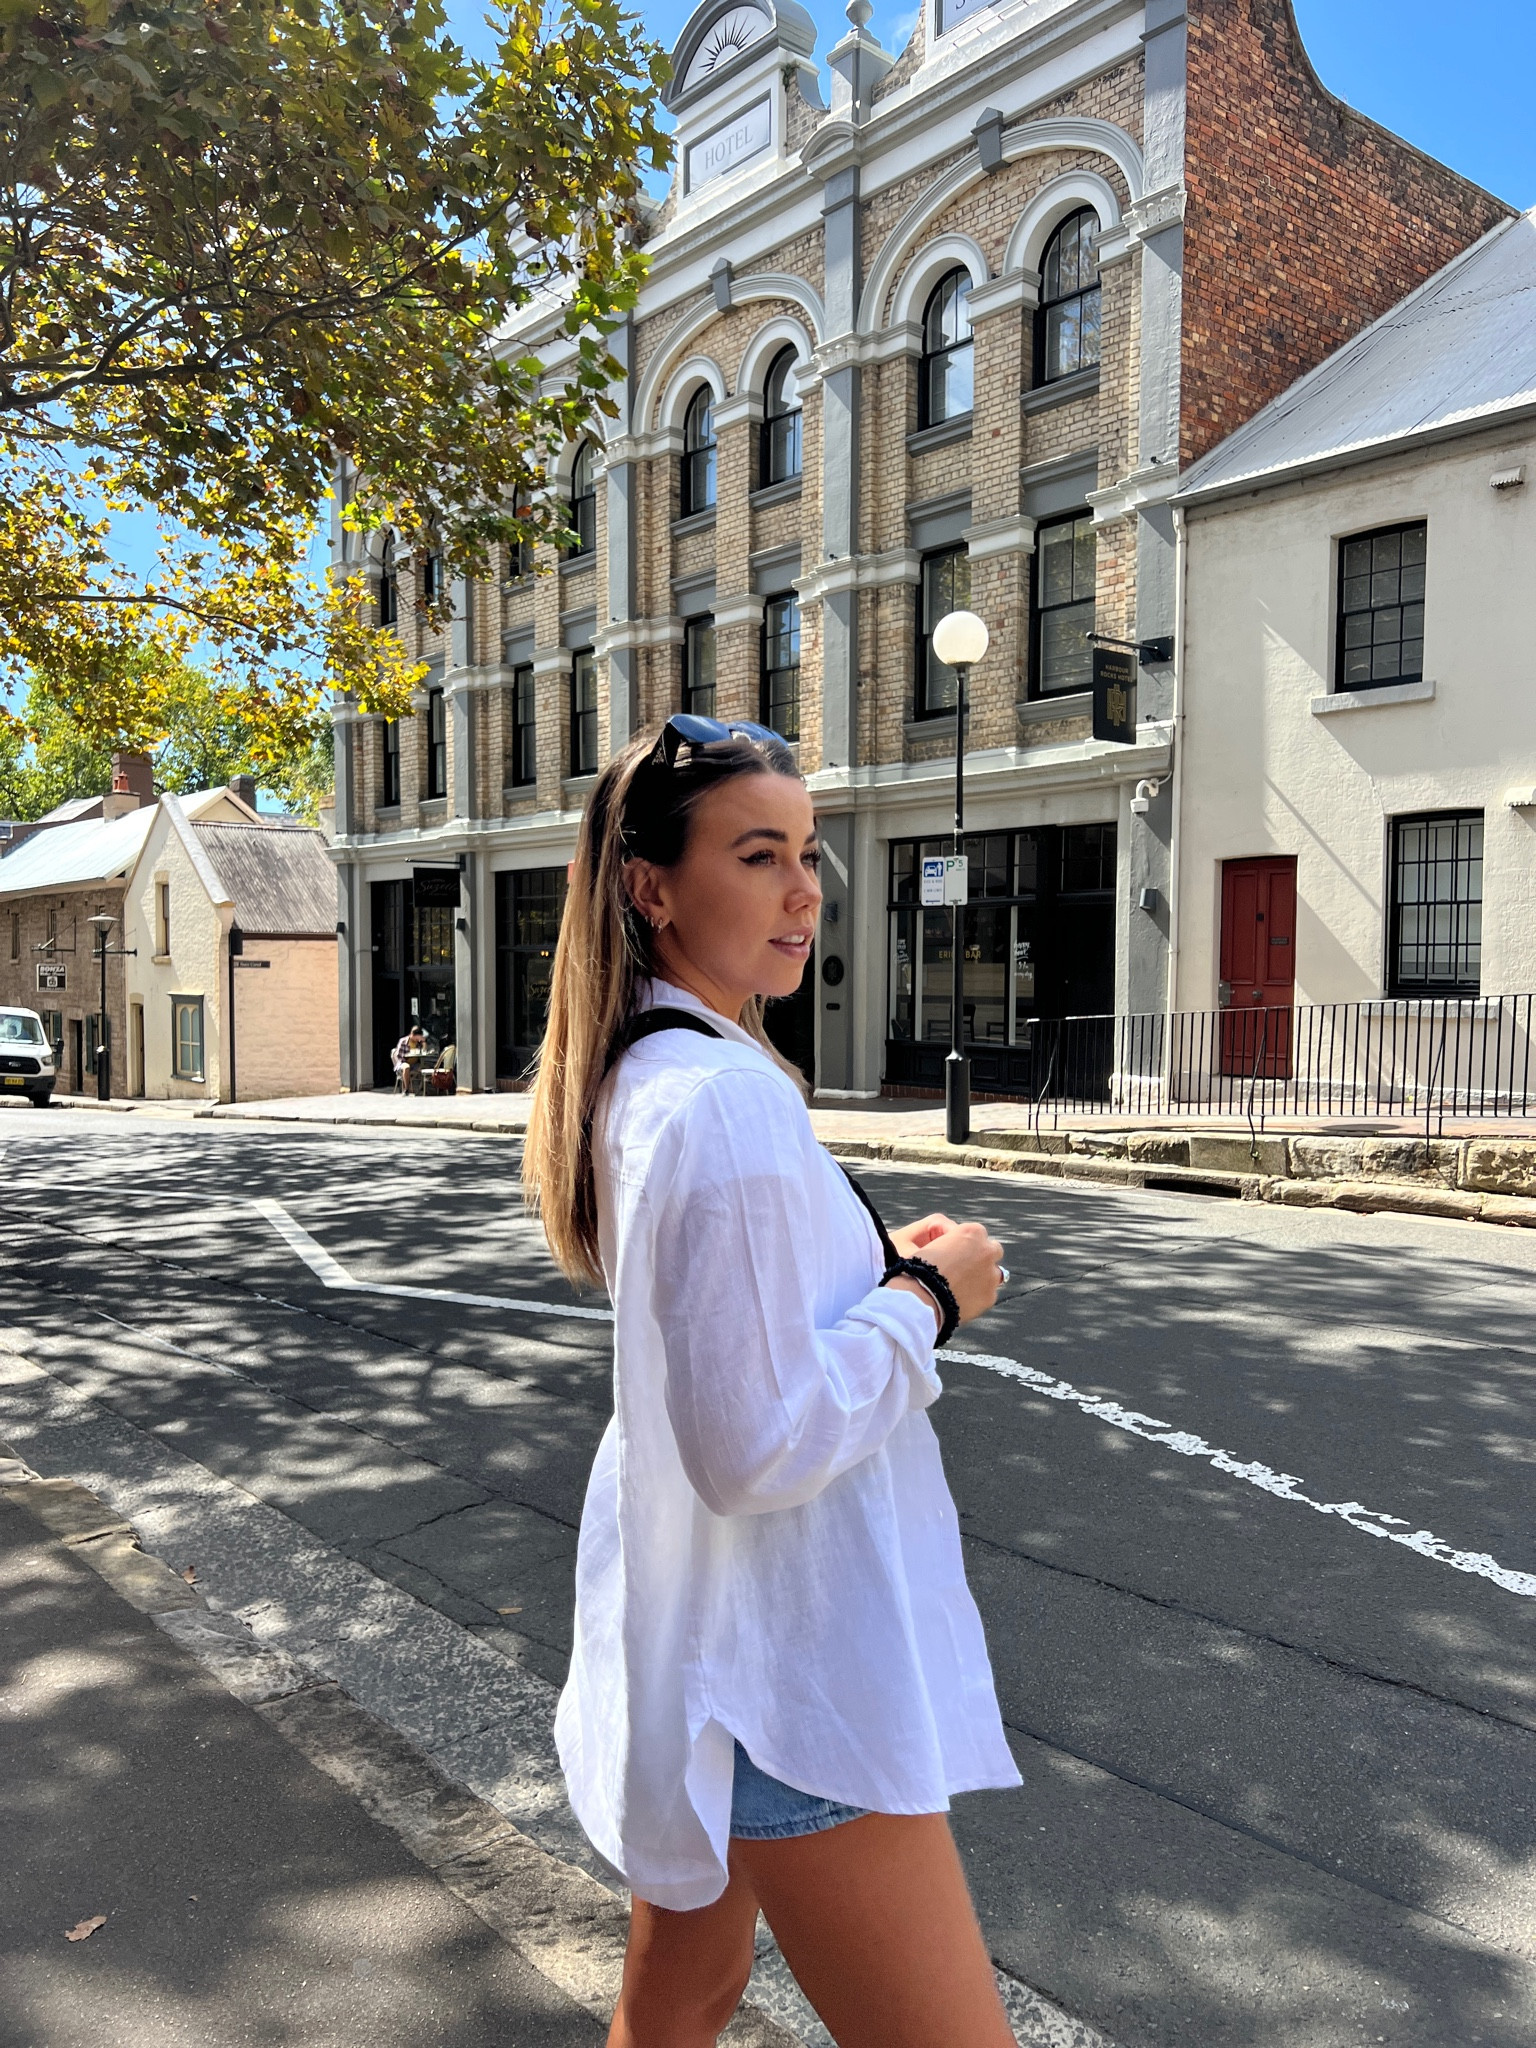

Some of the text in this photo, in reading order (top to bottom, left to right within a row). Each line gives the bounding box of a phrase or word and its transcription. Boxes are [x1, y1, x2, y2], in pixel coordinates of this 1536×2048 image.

[705, 126, 753, 169] HOTEL
[946, 859, 964, 872] P 5
[965, 950, 982, 959] BAR
